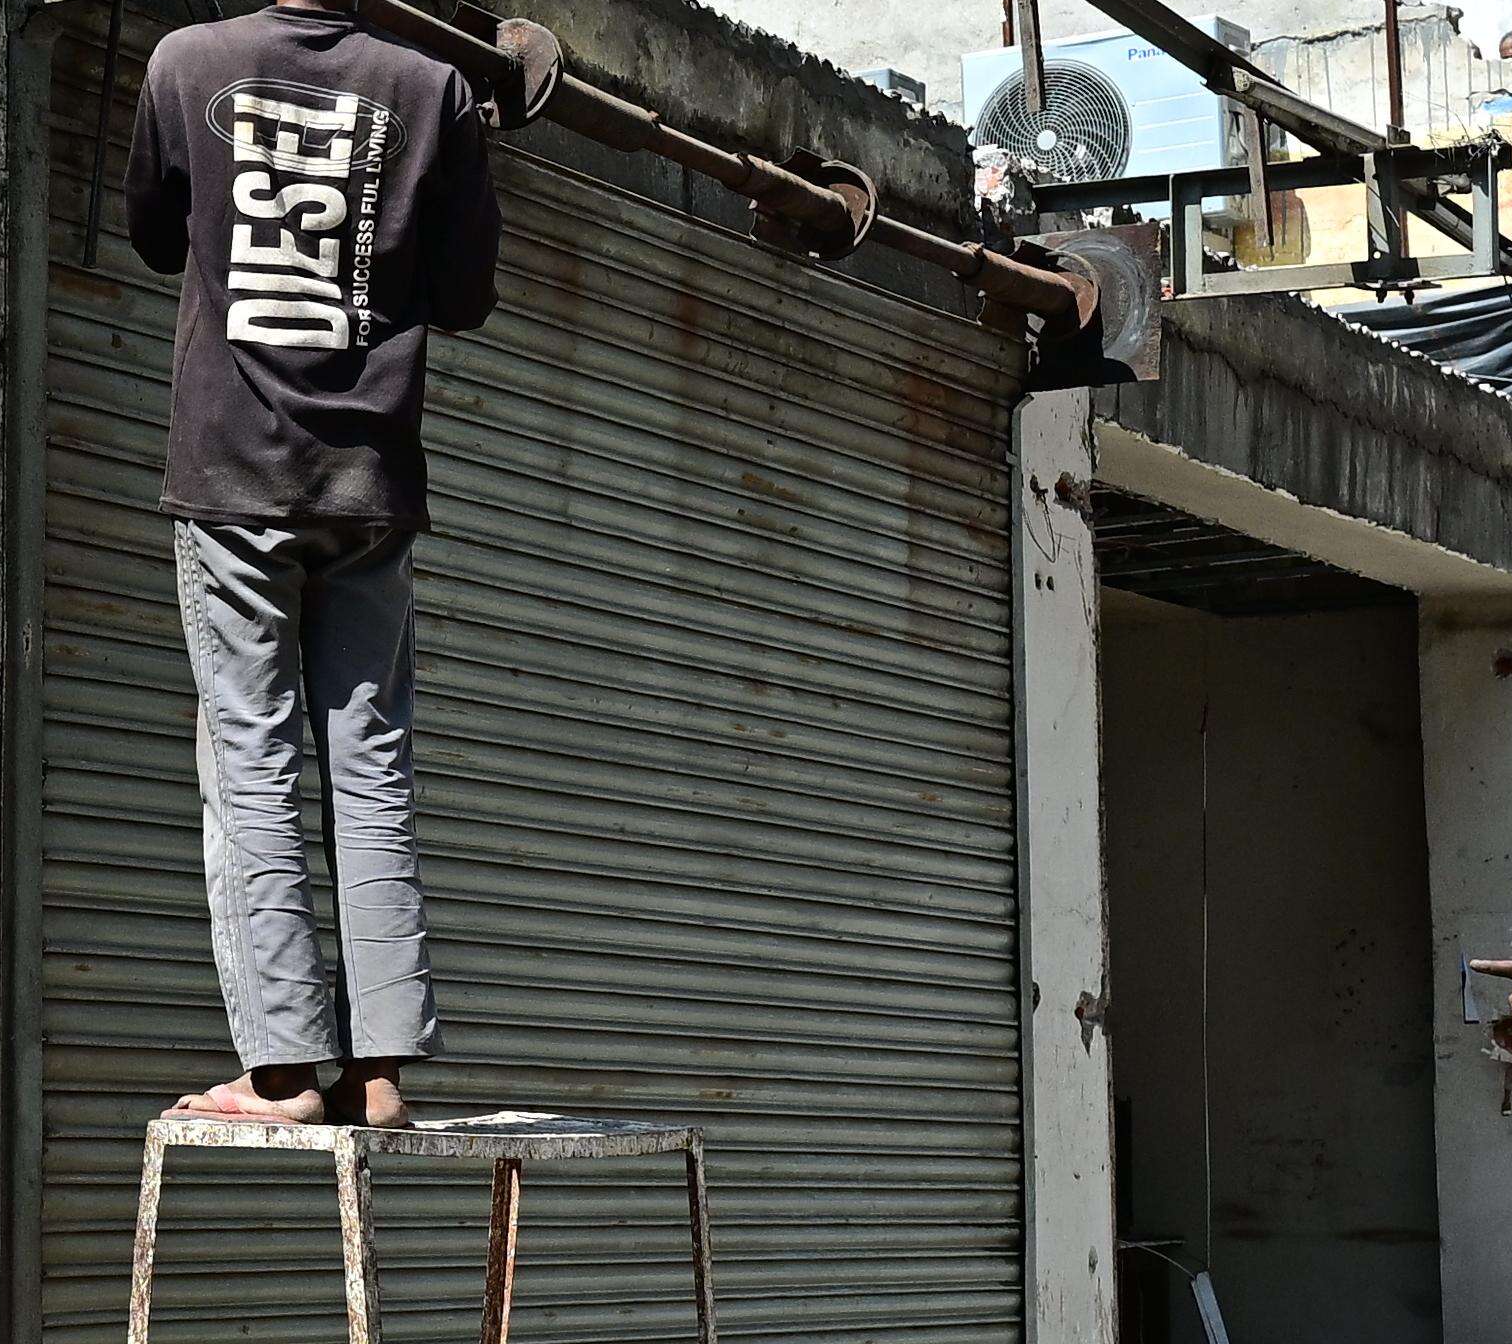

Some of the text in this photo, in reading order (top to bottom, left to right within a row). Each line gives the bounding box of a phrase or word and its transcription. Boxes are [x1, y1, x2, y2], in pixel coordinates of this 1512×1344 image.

[226, 93, 359, 350] DIESEL
[352, 219, 375, 307] SUCCESS
[356, 309, 372, 347] FOR
